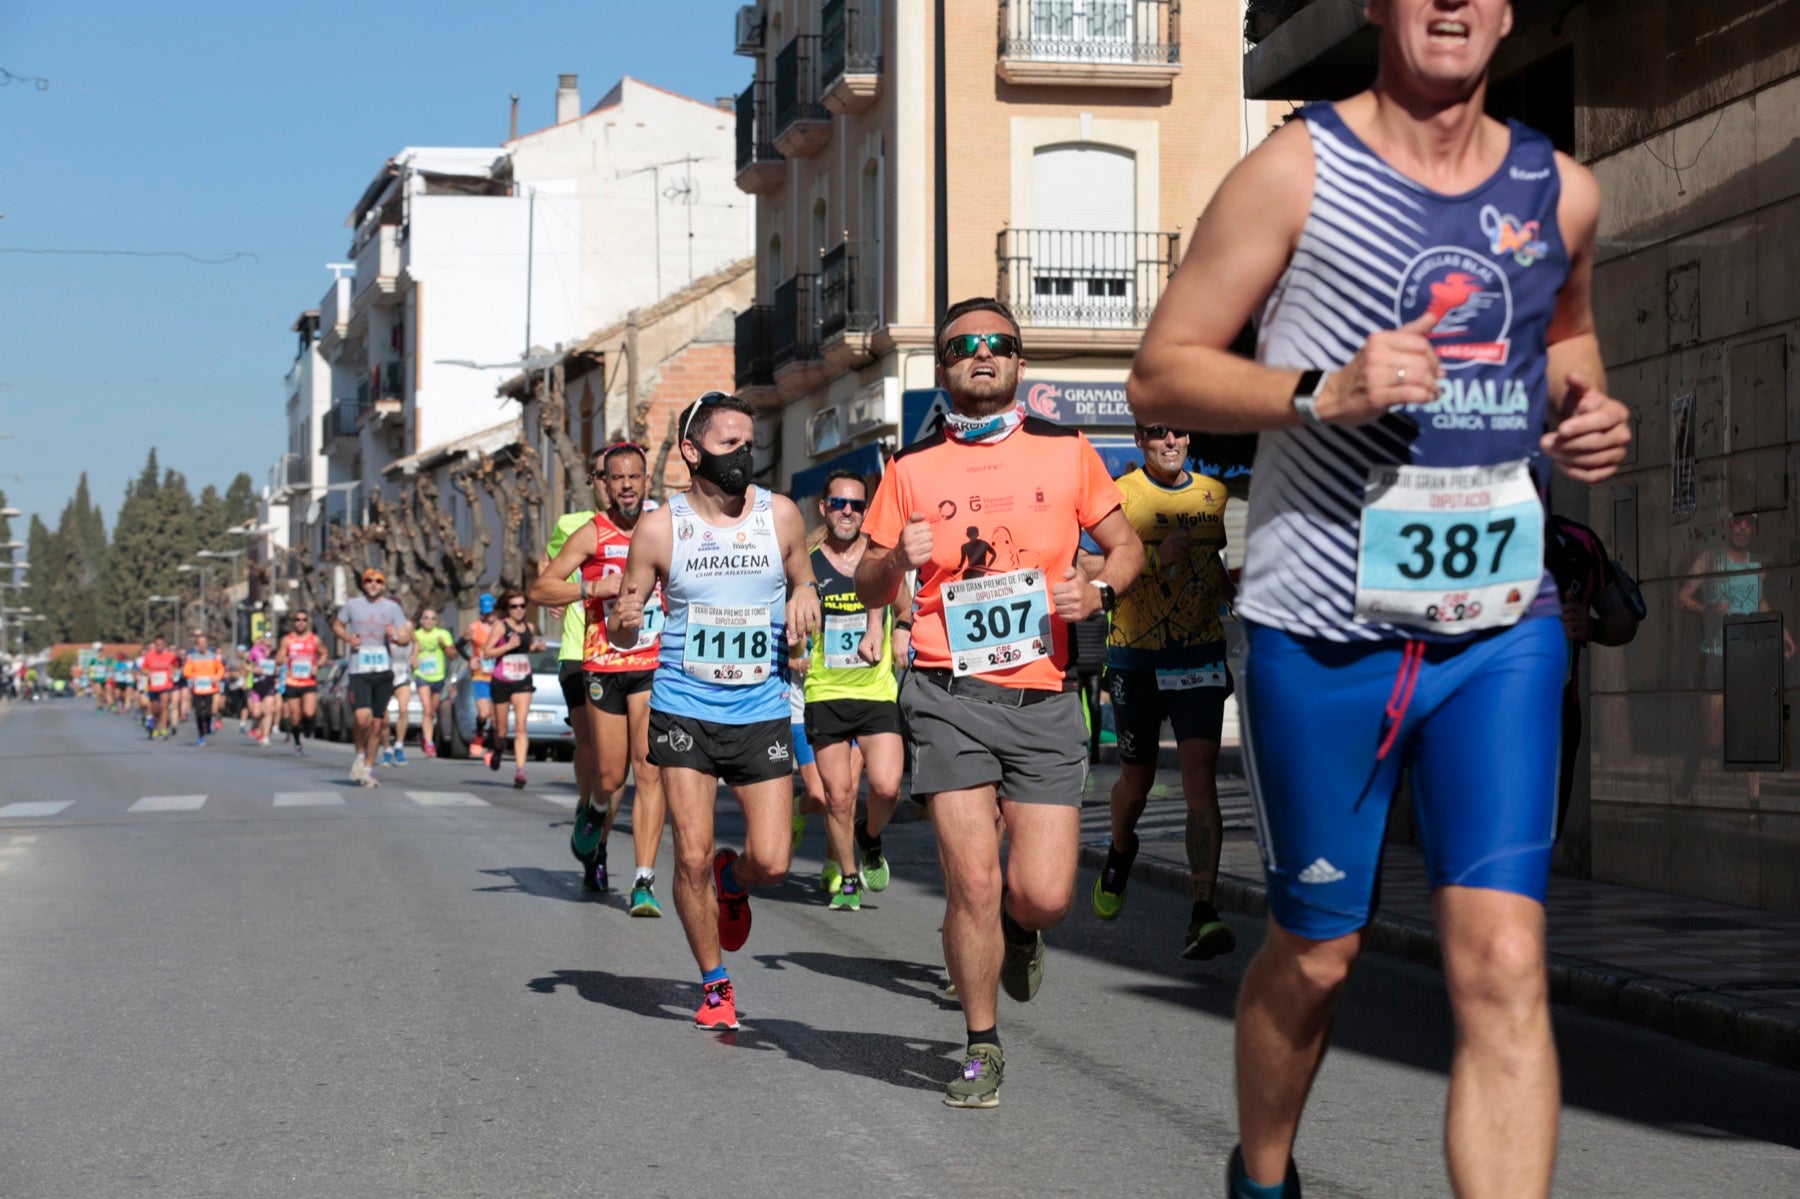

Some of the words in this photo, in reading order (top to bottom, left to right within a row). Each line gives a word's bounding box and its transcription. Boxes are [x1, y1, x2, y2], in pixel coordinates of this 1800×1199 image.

[1076, 402, 1096, 415] DE
[1396, 516, 1517, 580] 387
[685, 554, 770, 573] MARACENA
[966, 581, 983, 592] GRAN
[983, 577, 1008, 590] PREMIO
[1008, 574, 1017, 584] DE
[708, 607, 722, 616] GRAN
[723, 608, 743, 617] PREMIO
[744, 608, 751, 617] DE
[963, 599, 1032, 643] 307
[692, 628, 768, 659] 1118
